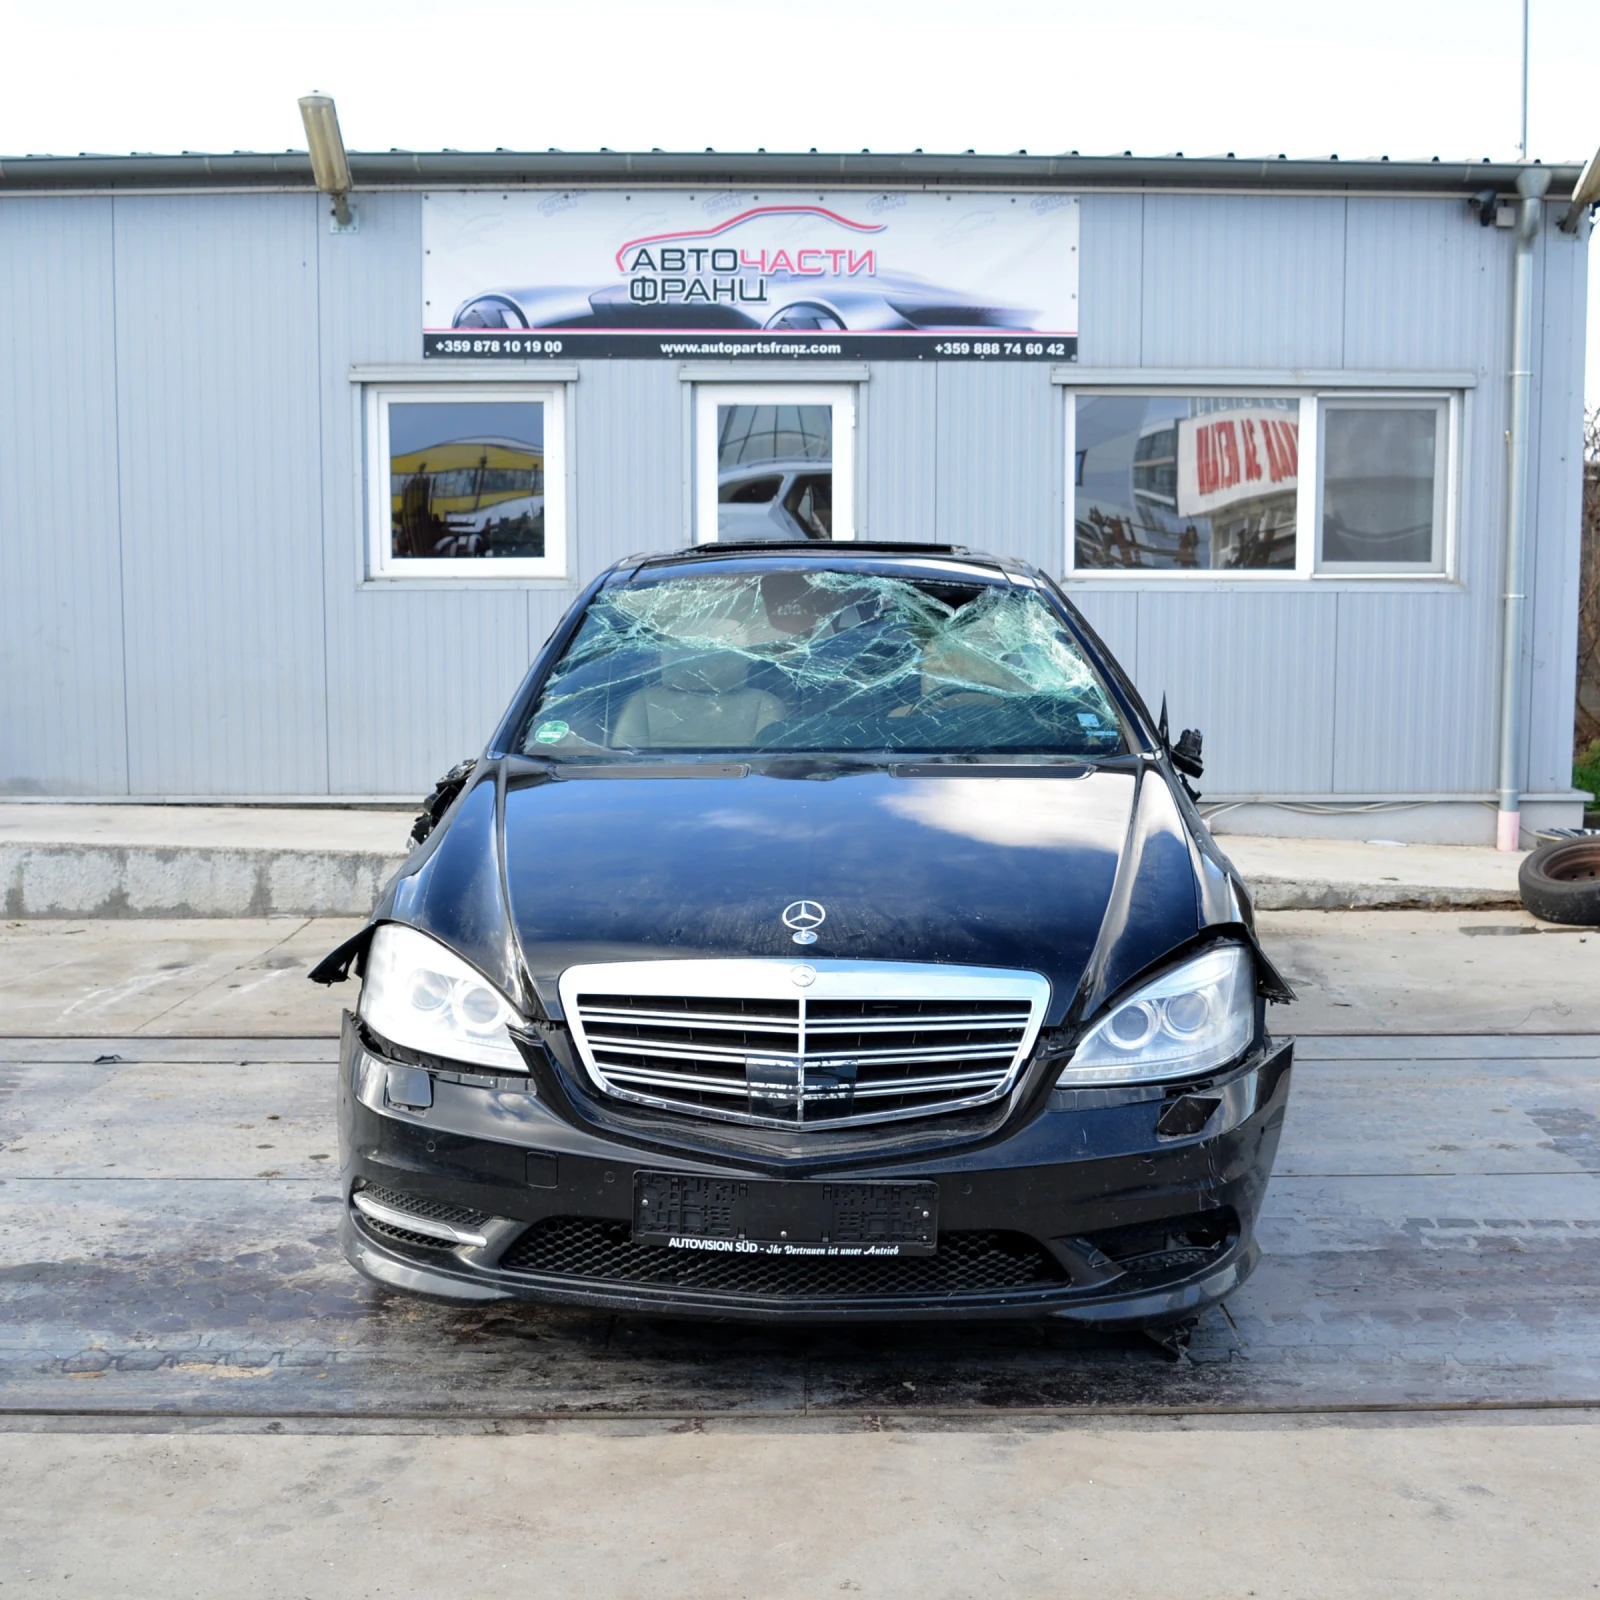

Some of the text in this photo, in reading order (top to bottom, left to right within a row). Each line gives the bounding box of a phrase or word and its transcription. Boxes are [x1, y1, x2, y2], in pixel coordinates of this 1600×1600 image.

[630, 248, 875, 273] АВТОЧАСТИ
[630, 276, 767, 302] ФРАНЦ
[435, 340, 563, 353] +359 878 10 19 00
[660, 341, 842, 356] www.autopartsfranz.com
[934, 342, 1065, 355] +359 888 74 60 42
[668, 1237, 733, 1252] AUTOVISION
[735, 1240, 758, 1253] SÜD
[784, 1244, 826, 1255] Vertrauen
[827, 1245, 839, 1255] ist
[840, 1247, 862, 1256] unser
[863, 1245, 899, 1256] Antrieb
